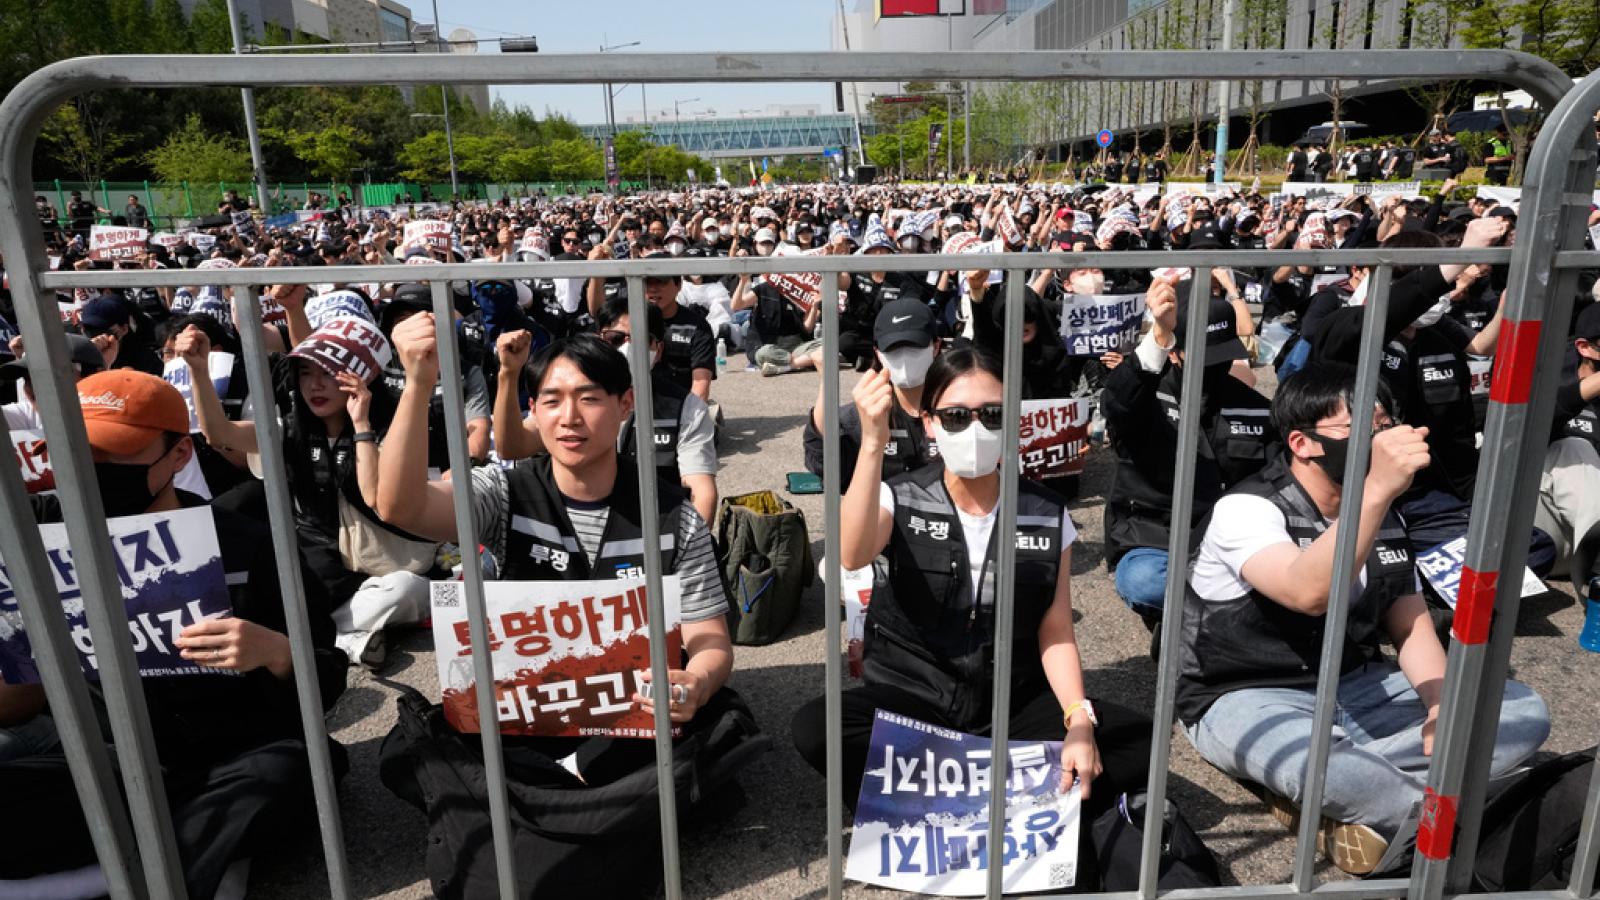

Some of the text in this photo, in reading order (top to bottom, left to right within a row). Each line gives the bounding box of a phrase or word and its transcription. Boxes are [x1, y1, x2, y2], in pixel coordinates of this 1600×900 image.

[95, 229, 140, 244] 투명하게
[1069, 297, 1137, 327] 상한폐지
[1073, 326, 1141, 355] 실현하자
[1423, 369, 1454, 382] SELU
[1020, 402, 1079, 438] 명하게
[1230, 424, 1264, 436] SELU
[654, 434, 671, 444] LU
[884, 441, 898, 456] 쟁
[908, 515, 950, 541] 투쟁
[529, 543, 570, 572] 투쟁
[1377, 549, 1409, 566] SELU
[616, 566, 646, 580] SEL
[876, 811, 1066, 878] 상한폐지
